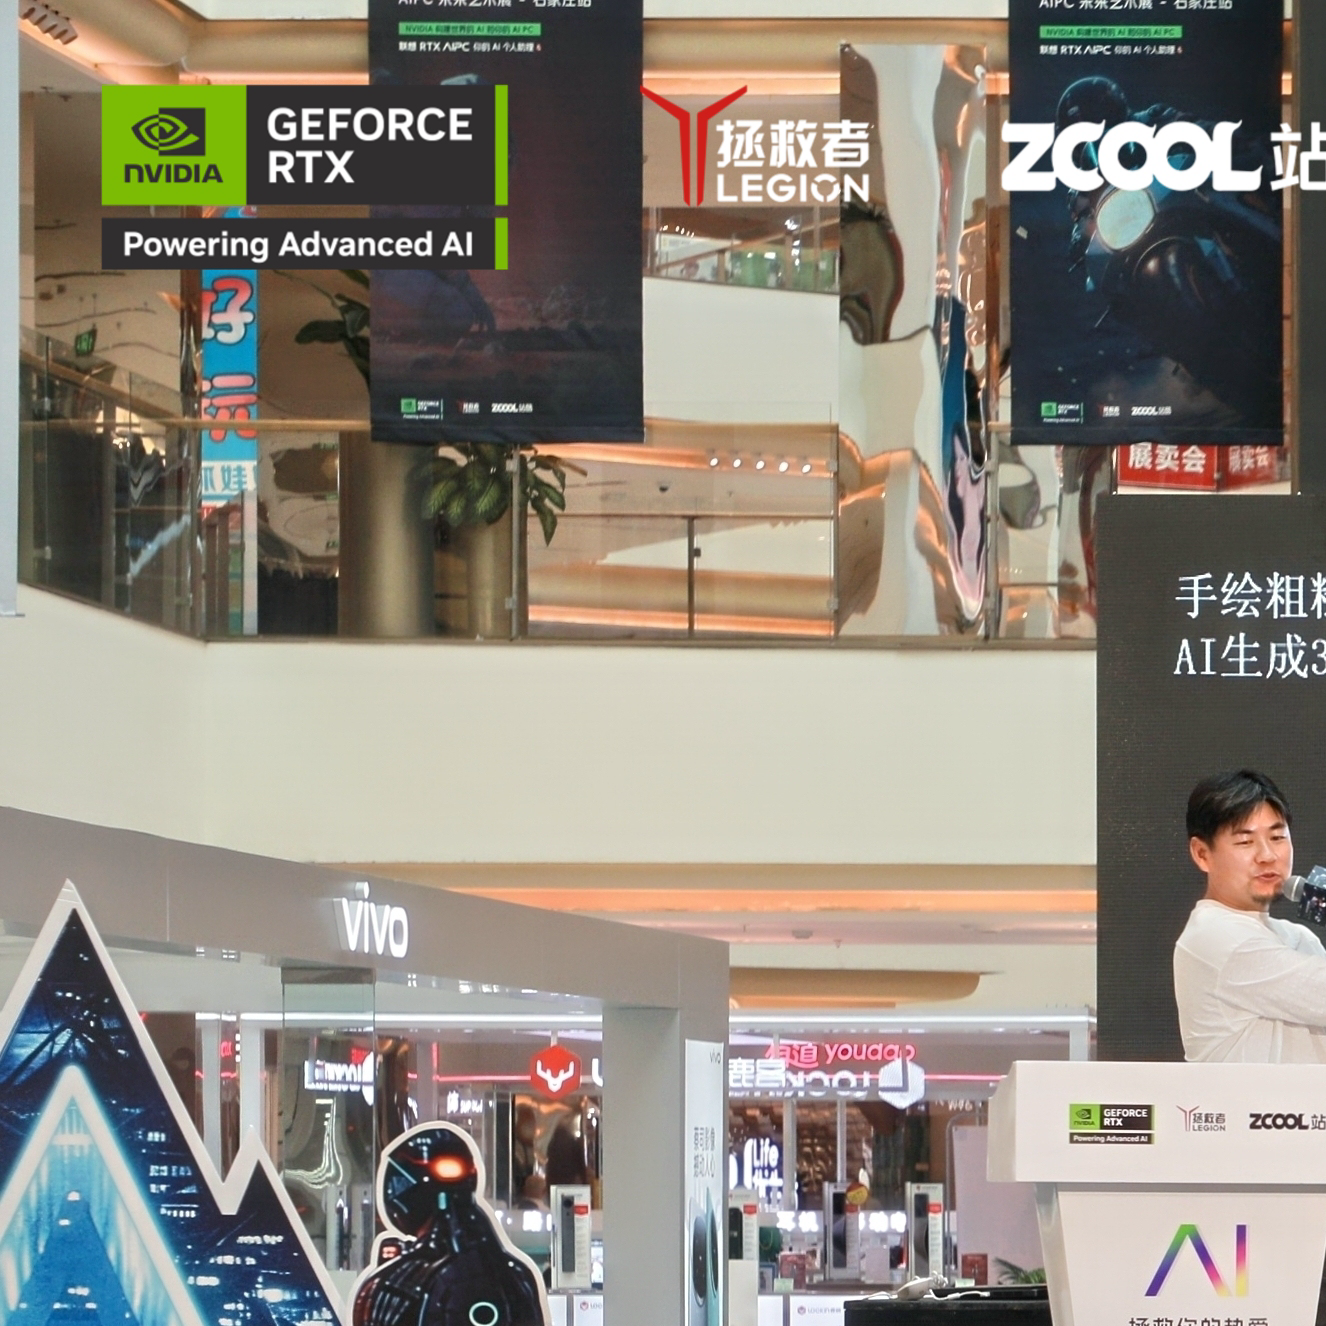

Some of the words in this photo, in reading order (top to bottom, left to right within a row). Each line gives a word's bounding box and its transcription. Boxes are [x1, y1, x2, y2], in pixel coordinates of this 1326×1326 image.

[339, 881, 409, 959] vivo
[709, 1052, 722, 1064] vivo
[824, 1042, 917, 1064] youdao
[1103, 1108, 1149, 1118] GEFORCE
[1192, 1112, 1226, 1124] 拯救者
[1103, 1117, 1124, 1127] RTX
[1249, 1112, 1310, 1130] ZCOOL
[1192, 1124, 1227, 1132] LEGION
[1073, 1134, 1105, 1144] Powering
[1106, 1133, 1140, 1143] Advanced
[1140, 1134, 1149, 1143] AI
[1144, 1224, 1249, 1297] AI
